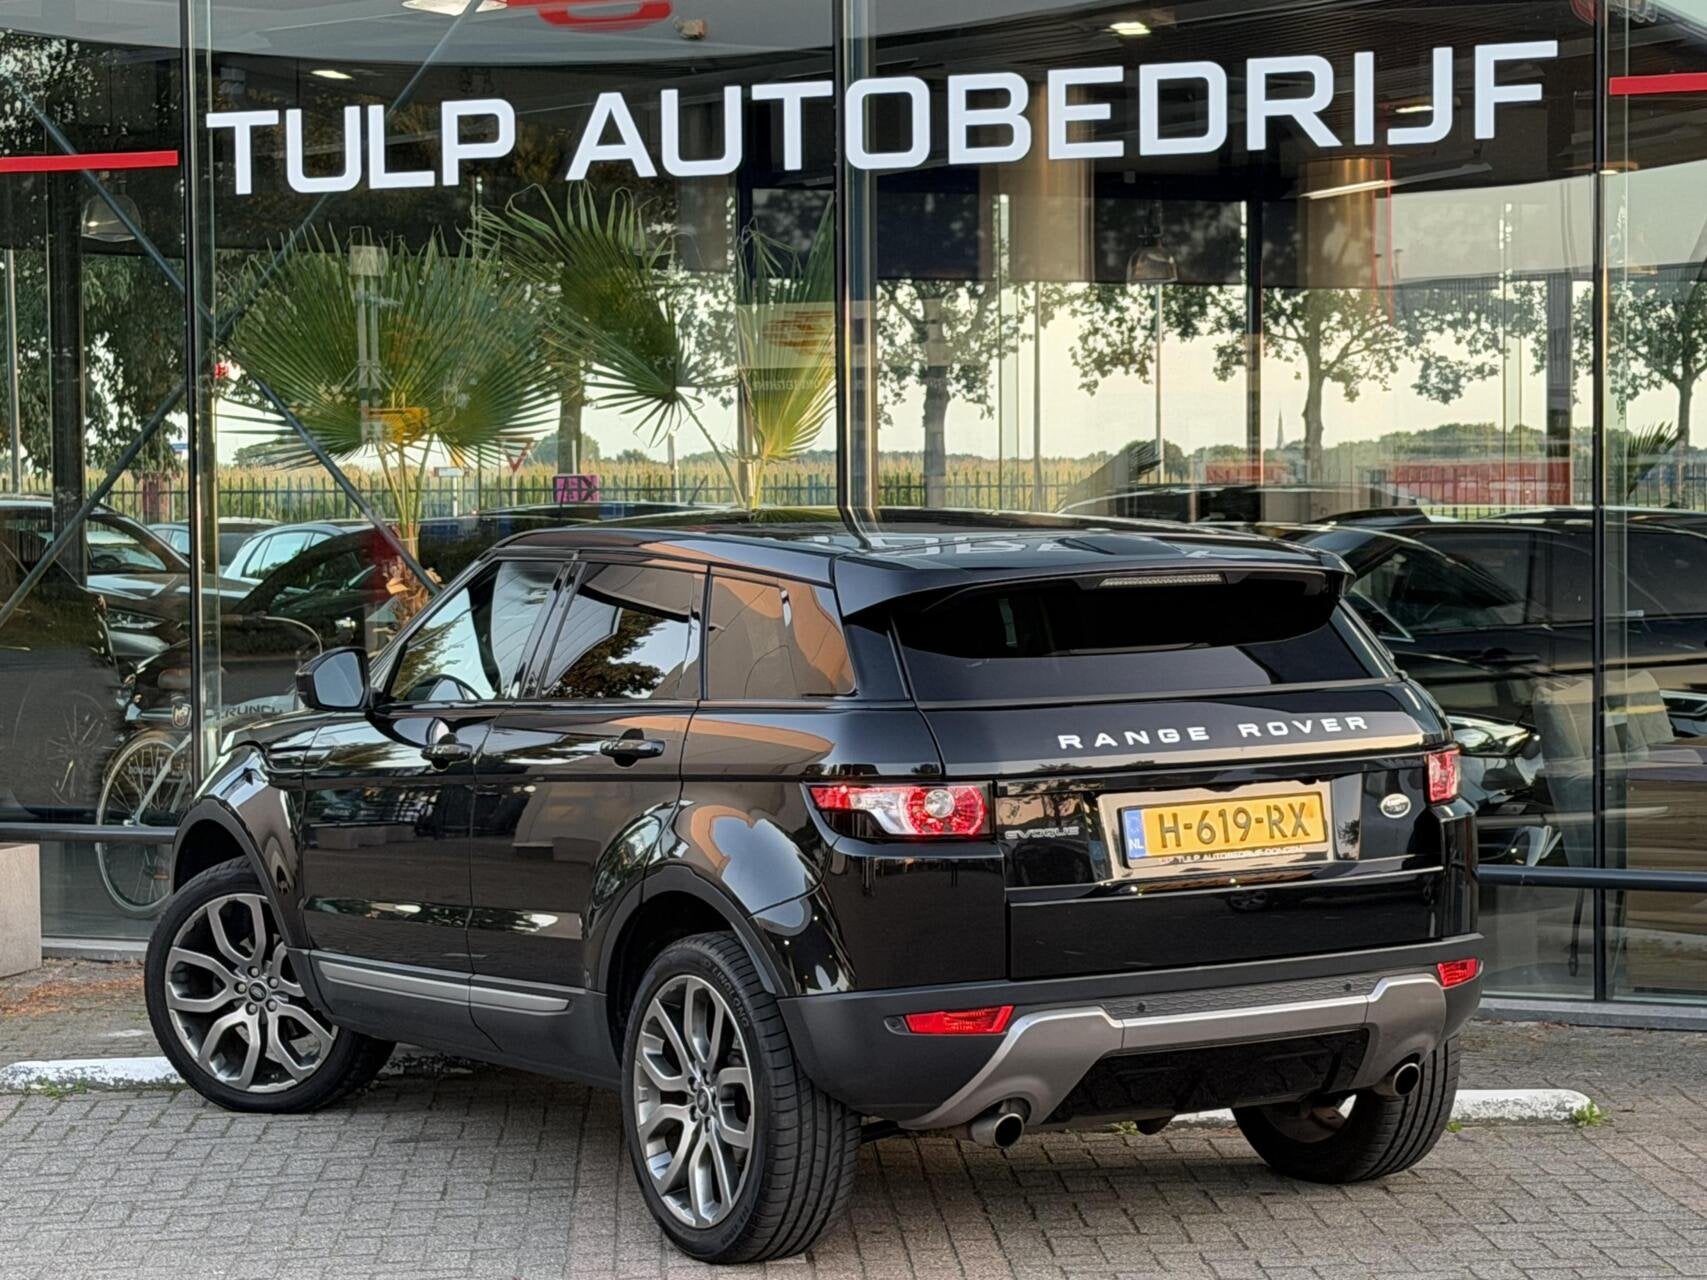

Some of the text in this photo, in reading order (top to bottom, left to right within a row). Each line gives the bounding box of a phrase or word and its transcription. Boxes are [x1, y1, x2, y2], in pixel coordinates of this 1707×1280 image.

[206, 40, 1558, 195] TULP AUTOBEDRIJF
[1057, 716, 1369, 750] RANGE ROVER
[1004, 826, 1080, 840] EVOQUE
[1157, 801, 1311, 849] H-619-RX
[1128, 838, 1145, 850] NL
